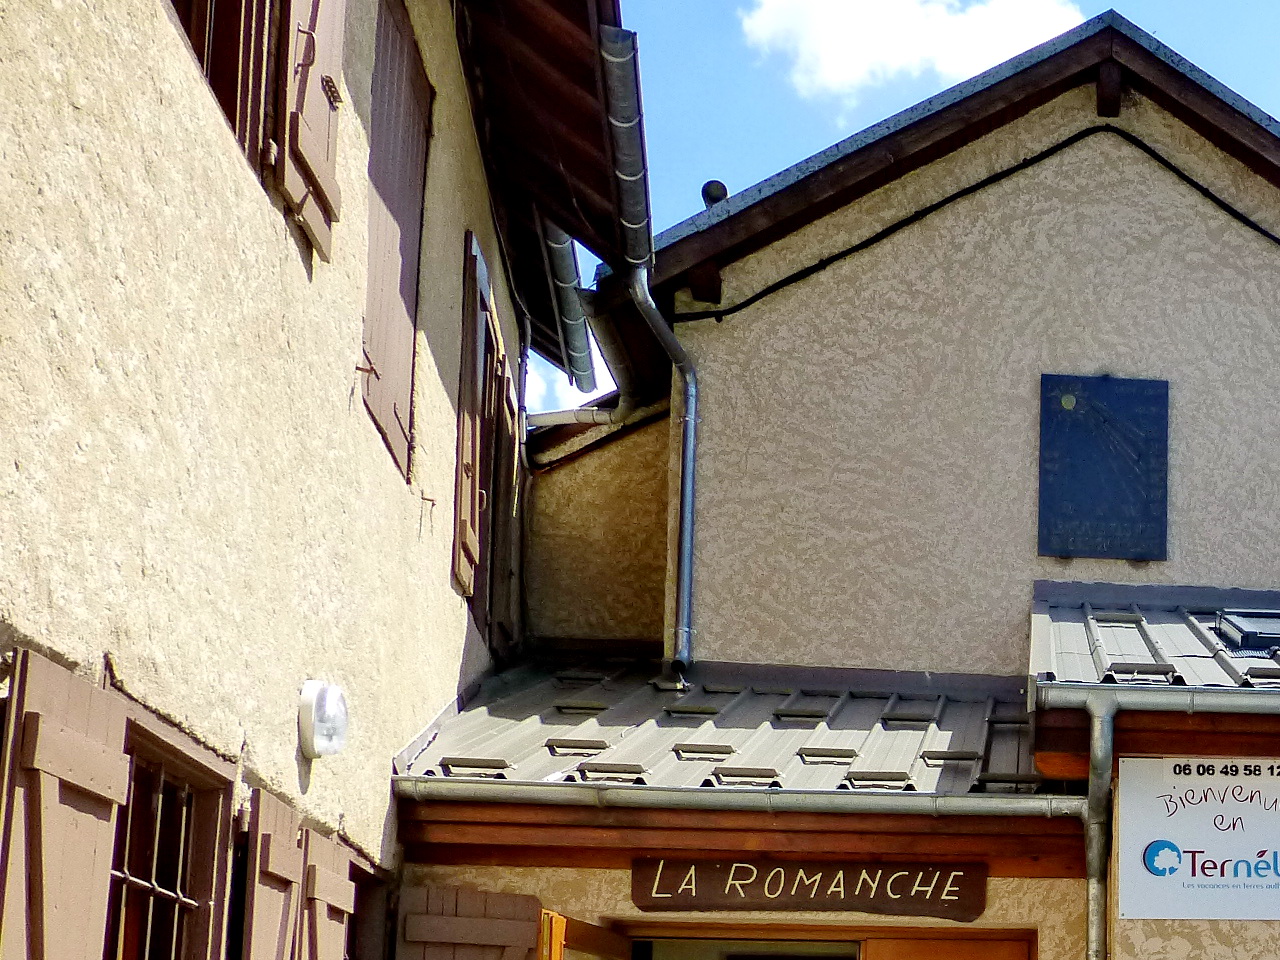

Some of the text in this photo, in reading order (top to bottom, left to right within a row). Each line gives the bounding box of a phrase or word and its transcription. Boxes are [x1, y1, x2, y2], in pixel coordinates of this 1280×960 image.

[1173, 764, 1191, 776] 06
[1196, 764, 1215, 776] 06
[1220, 764, 1239, 777] 49
[1243, 764, 1261, 777] 58
[1213, 814, 1245, 832] en
[652, 859, 964, 900] LA ROMANCHE
[1182, 881, 1195, 889] Les
